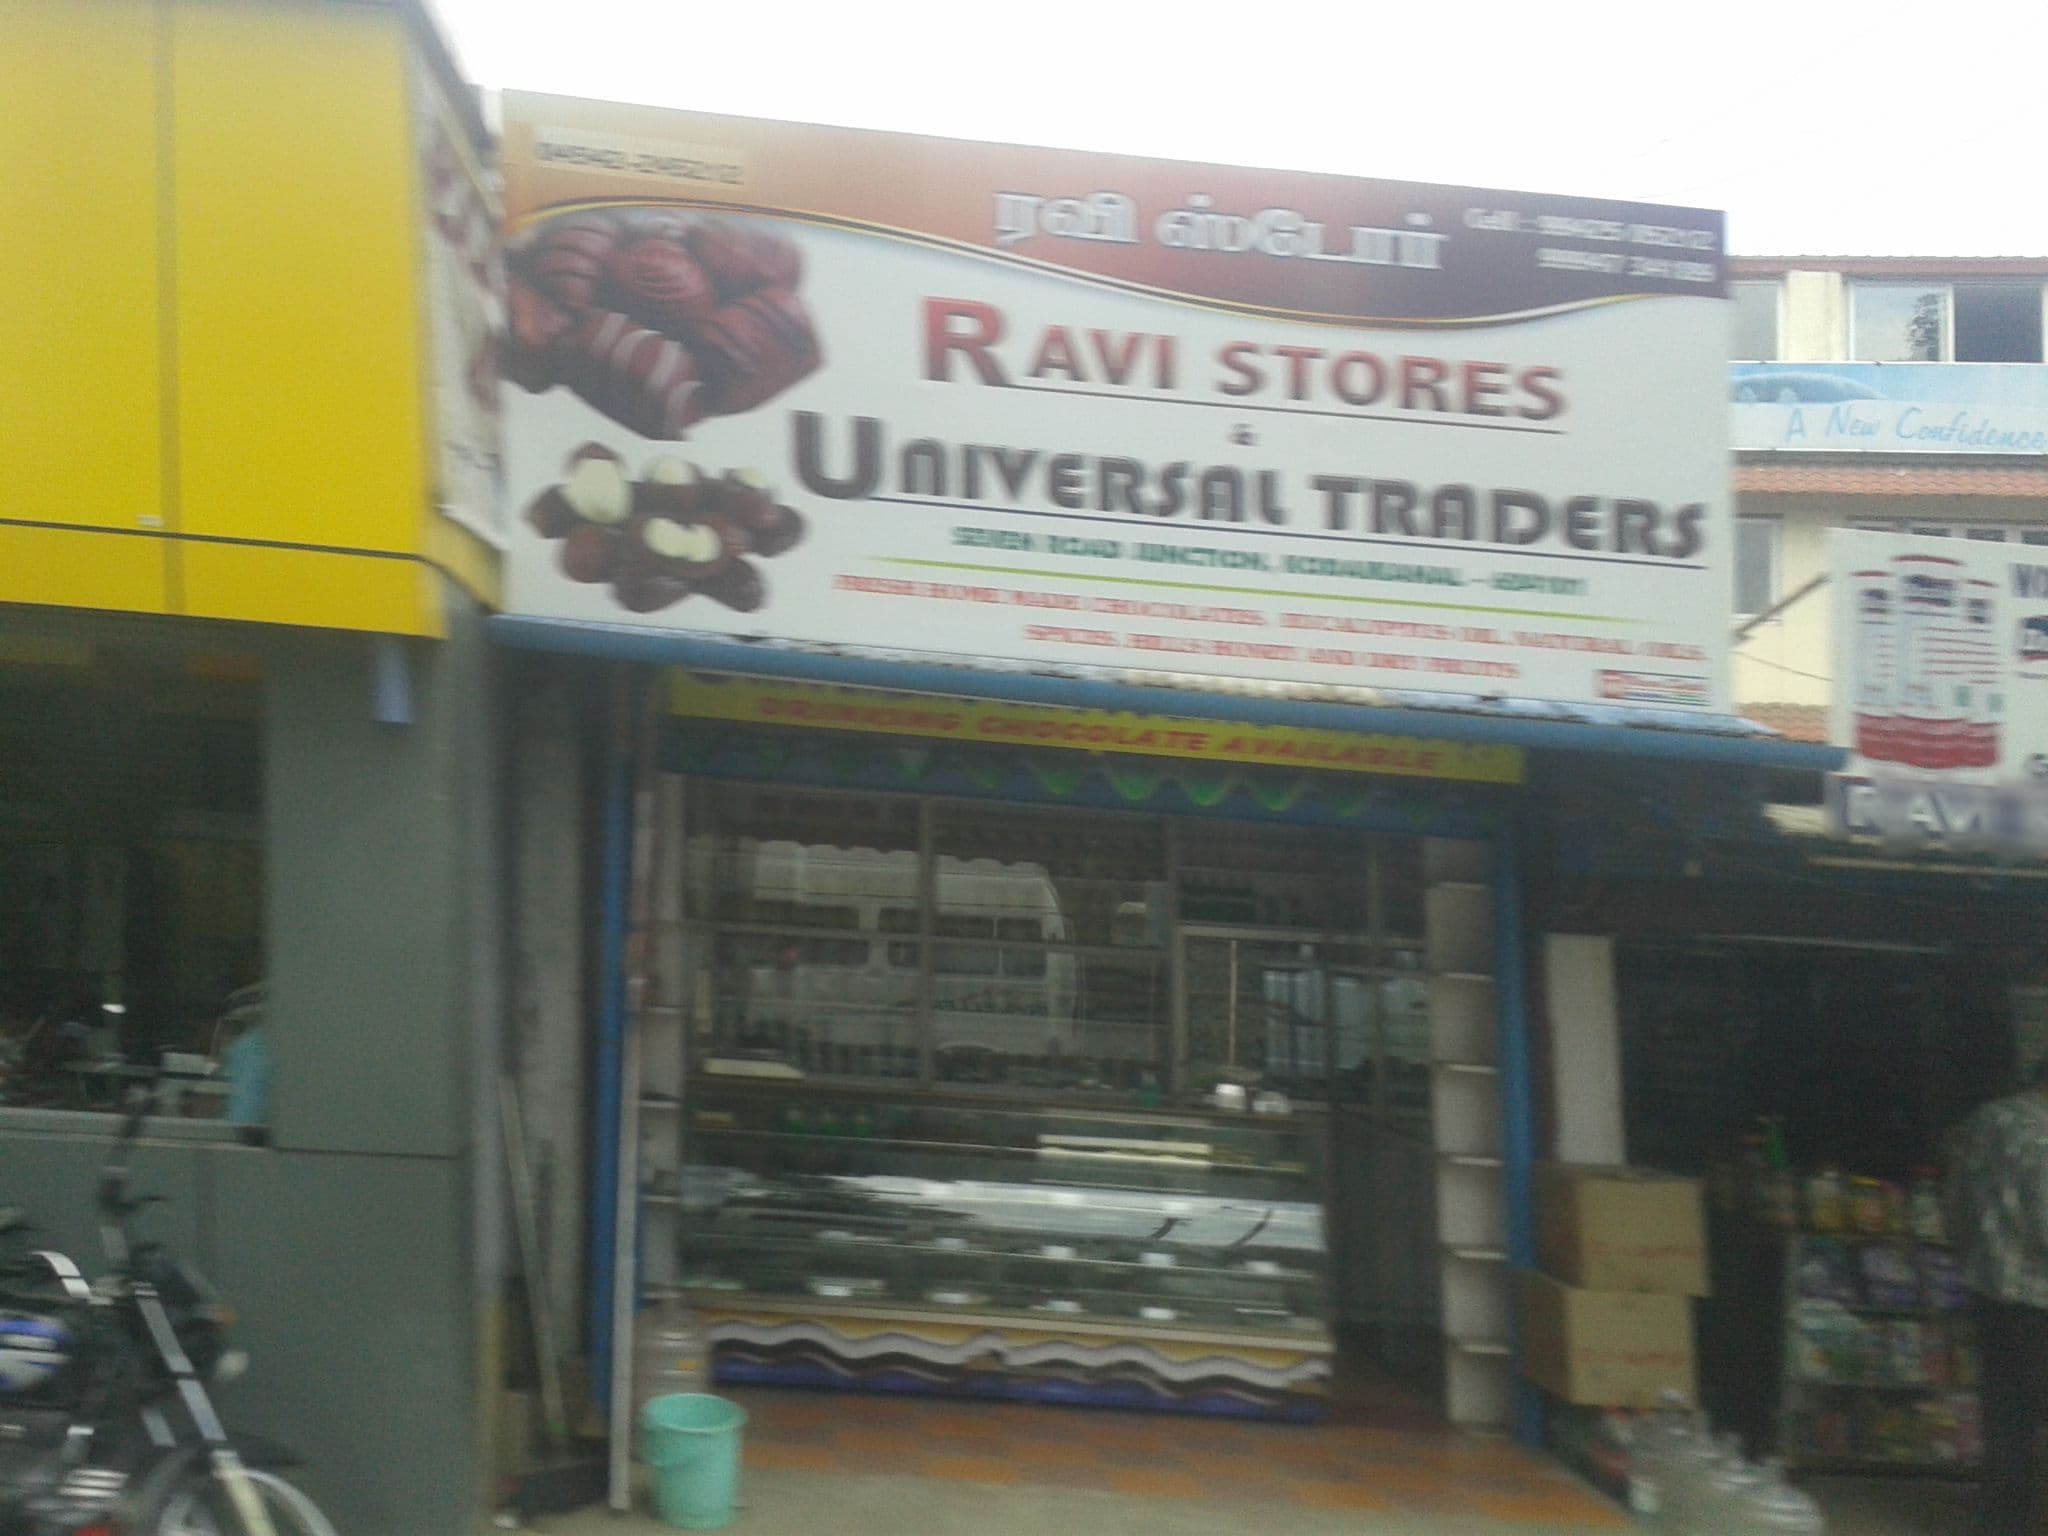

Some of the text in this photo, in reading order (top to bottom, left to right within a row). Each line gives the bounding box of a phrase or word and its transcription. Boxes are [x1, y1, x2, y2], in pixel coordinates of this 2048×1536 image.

[992, 191, 1140, 247] ரவி
[921, 296, 1567, 422] RAVI STORES
[1786, 408, 1806, 442] A
[1826, 404, 1880, 437] New
[790, 409, 1708, 560] UNIVERSAL TRADERS
